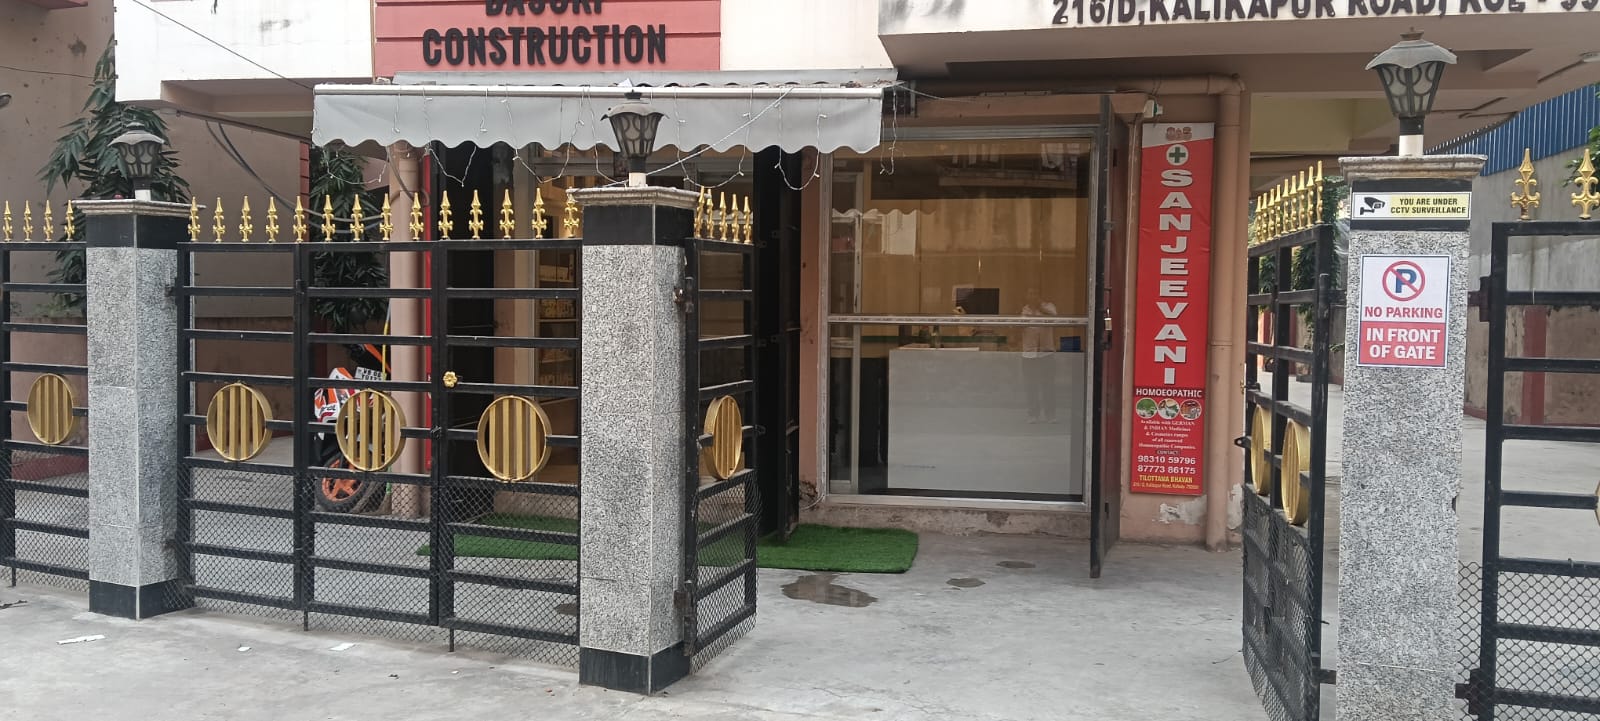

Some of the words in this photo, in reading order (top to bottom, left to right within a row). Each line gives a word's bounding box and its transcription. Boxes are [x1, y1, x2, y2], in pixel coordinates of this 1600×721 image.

[422, 24, 666, 66] CONSTRUCTION
[1399, 198, 1414, 206] YOU
[1416, 198, 1431, 206] ARE
[1390, 206, 1410, 214] CCTV
[1411, 206, 1466, 214] SURVEILLANCE
[1154, 169, 1193, 385] SANJEEVANI
[1364, 306, 1382, 318] NO
[1386, 306, 1443, 319] PARKING
[1366, 328, 1384, 342] IN
[1387, 328, 1441, 343] FRONT
[1369, 345, 1391, 358] OF
[1394, 345, 1436, 360] GATE
[1136, 388, 1202, 397] HOMOEOPATHIC
[1137, 455, 1166, 463] 98310
[1168, 456, 1196, 465] 59796
[1137, 464, 1166, 473] 87773
[1168, 466, 1196, 475] 86175
[1170, 475, 1193, 483] BHAVAN
